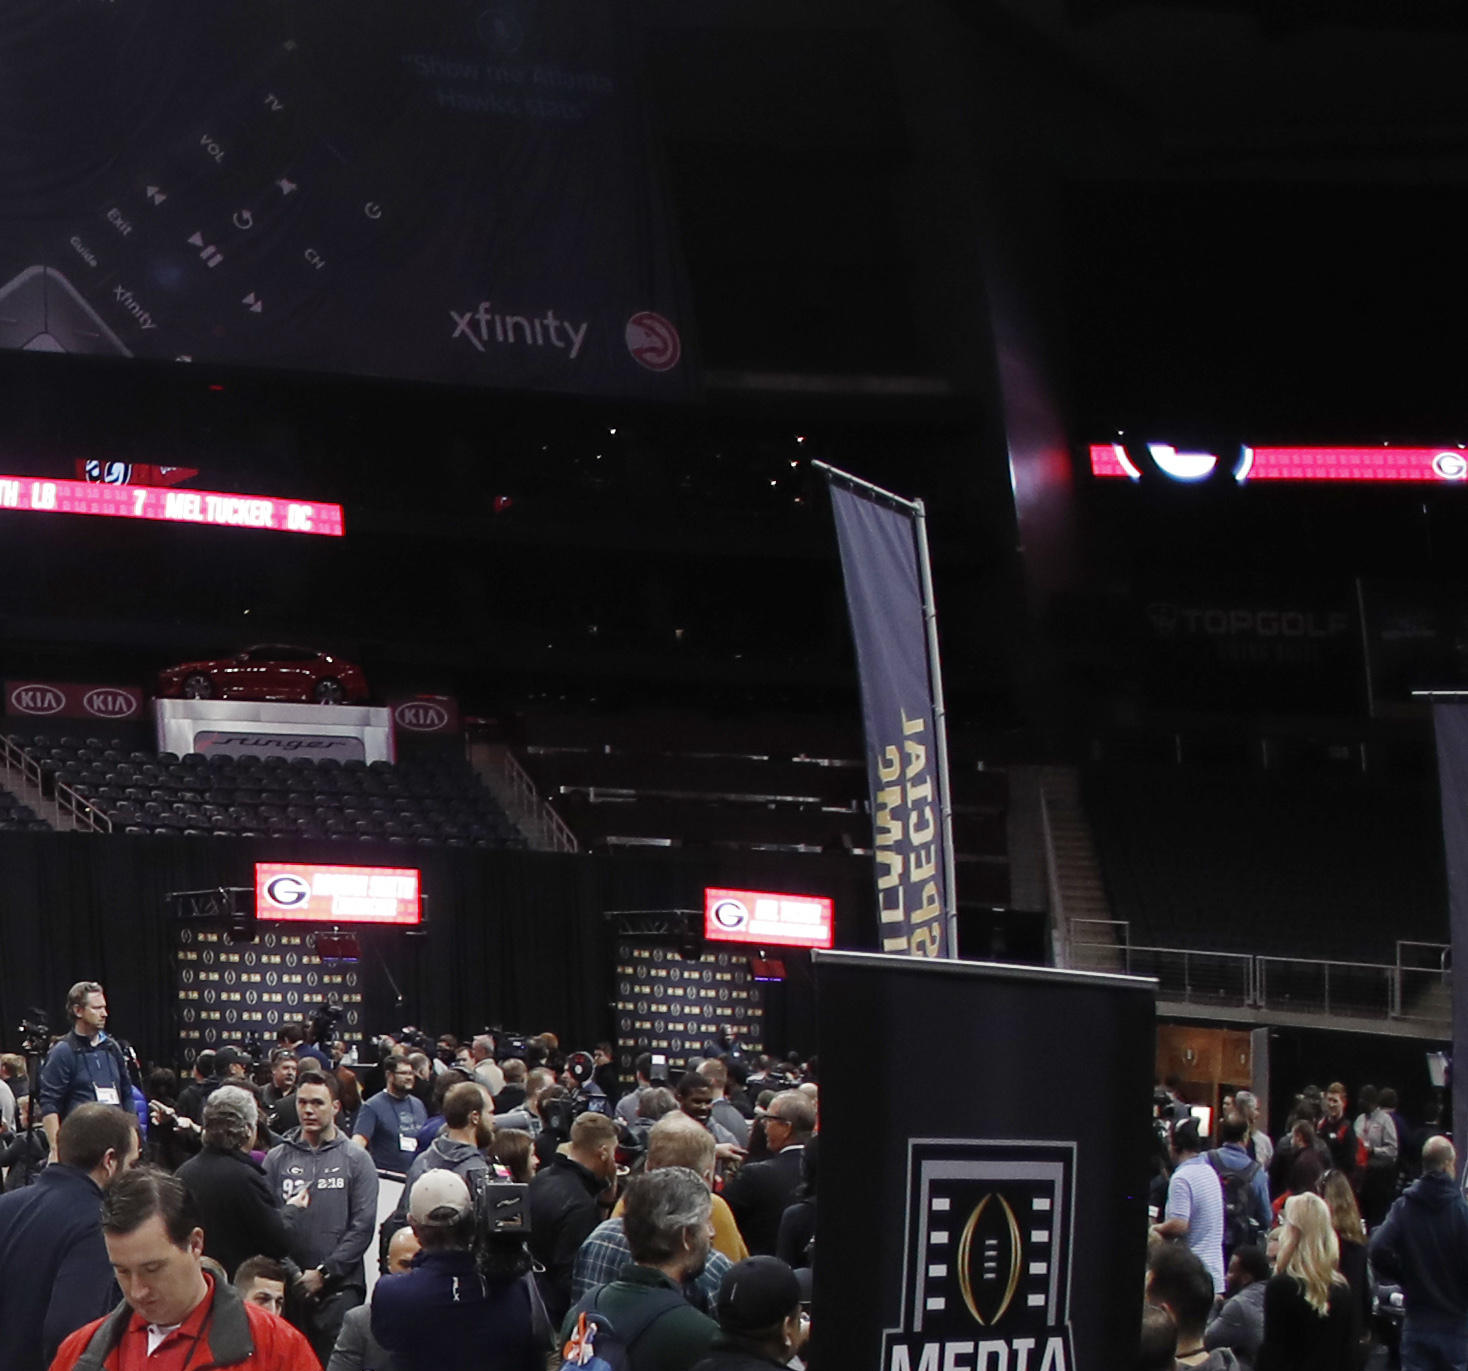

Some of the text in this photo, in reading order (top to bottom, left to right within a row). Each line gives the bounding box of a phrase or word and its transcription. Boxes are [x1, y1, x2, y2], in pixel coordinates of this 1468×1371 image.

[263, 92, 284, 112] TV
[199, 133, 225, 164] VOL
[106, 207, 134, 237] Exit
[69, 235, 99, 268] Guide
[303, 247, 327, 271] CH
[449, 302, 590, 361] xfinity
[30, 482, 57, 510] LB
[132, 489, 146, 517] 7
[163, 493, 203, 522] MEL
[202, 495, 273, 529] TUCKER
[286, 503, 313, 531] DC
[1180, 608, 1350, 638] TOPGOLF
[15, 691, 62, 710] KIA
[86, 694, 134, 713] KIA
[398, 707, 445, 726] KIA
